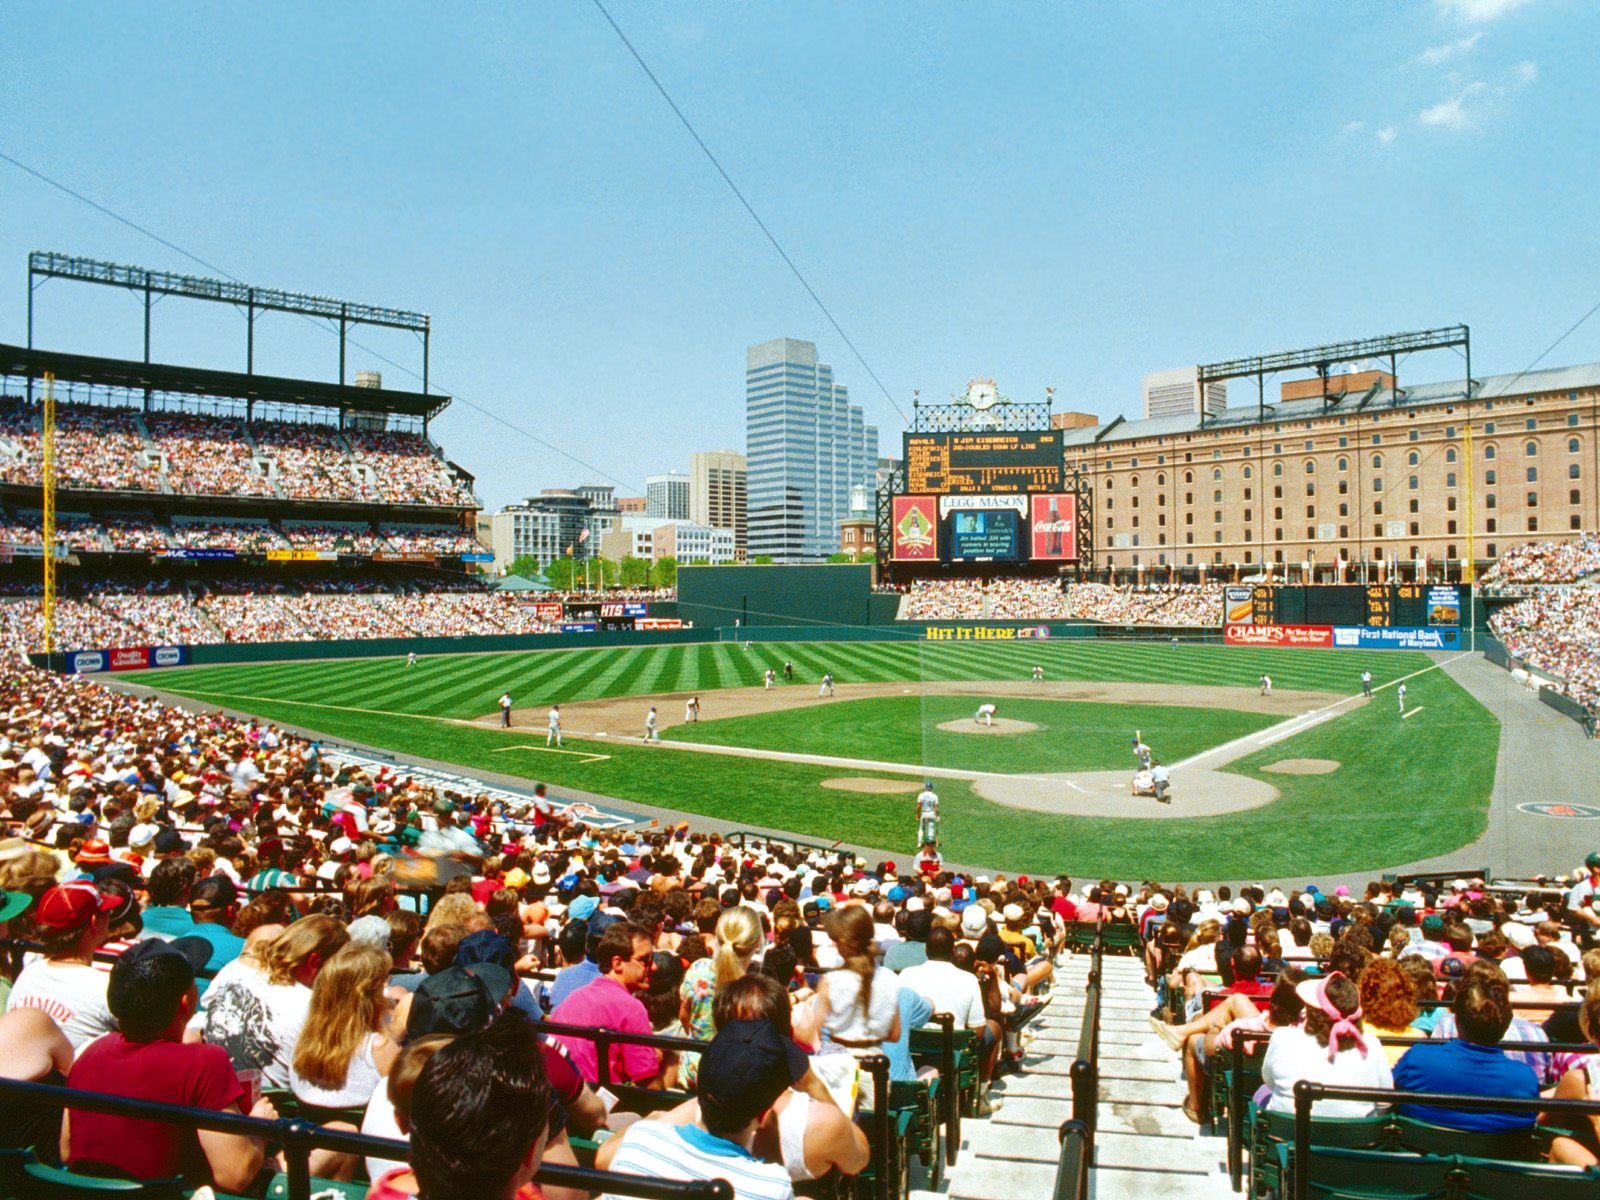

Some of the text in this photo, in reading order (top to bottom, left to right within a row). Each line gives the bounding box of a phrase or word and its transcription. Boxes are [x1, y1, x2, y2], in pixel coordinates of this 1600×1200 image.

[944, 496, 1024, 507] LEGG MASON
[1034, 520, 1072, 532] Coca-Cola
[601, 604, 624, 616] HTS
[1228, 626, 1284, 640] CHAMPS
[1296, 628, 1308, 636] Your
[1308, 630, 1330, 638] Average
[1362, 629, 1440, 641] First National Bank
[1408, 640, 1438, 648] Maryland
[117, 651, 142, 660] Quality
[112, 658, 147, 666] Gasolines
